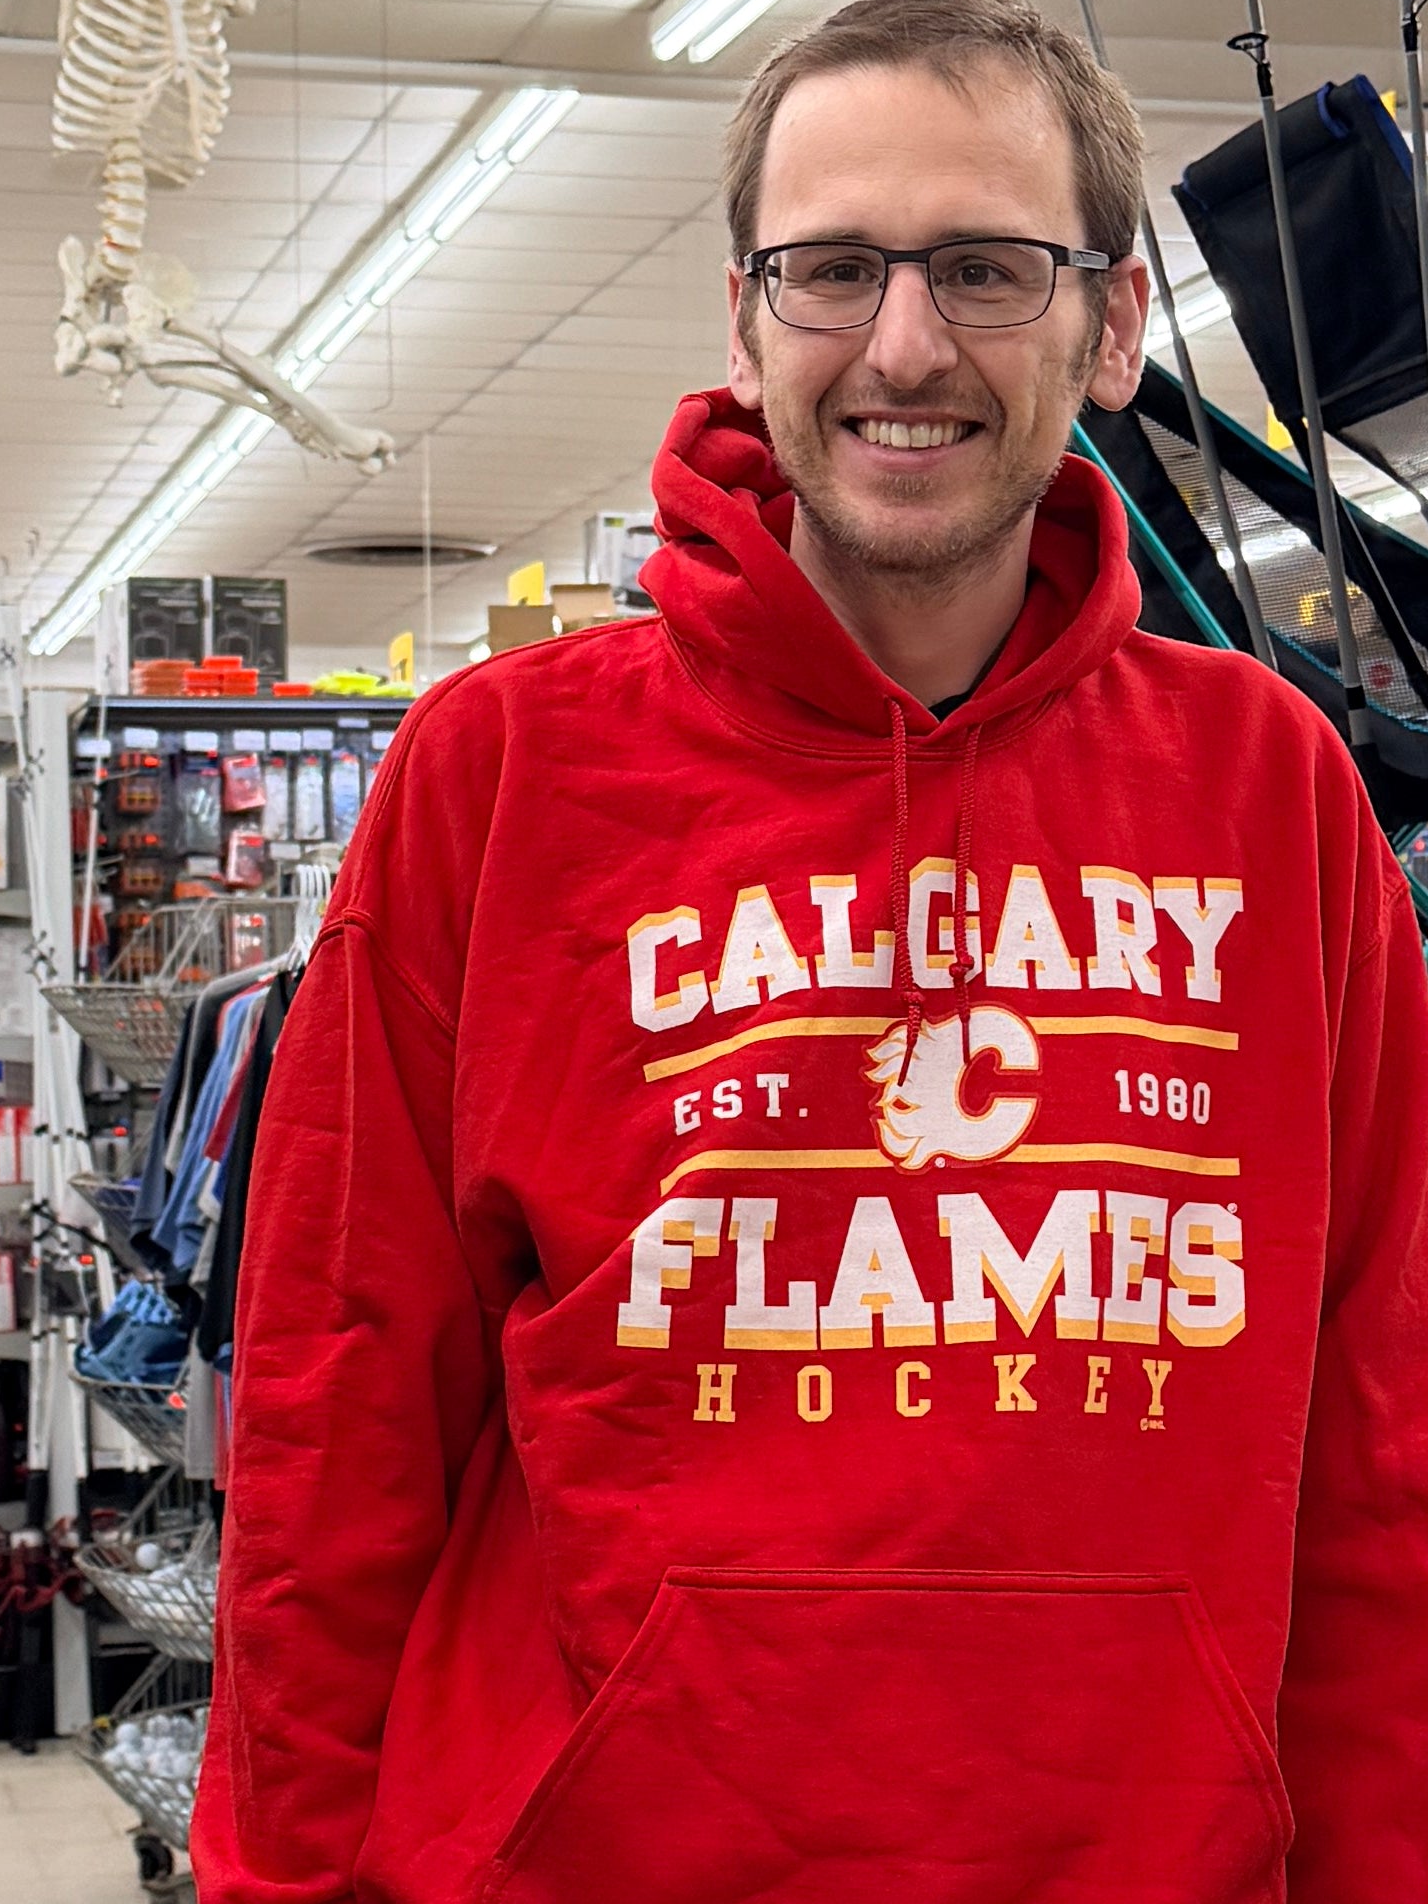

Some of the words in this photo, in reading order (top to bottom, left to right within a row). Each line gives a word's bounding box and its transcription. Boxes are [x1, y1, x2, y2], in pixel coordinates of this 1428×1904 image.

[626, 856, 1244, 1034] CALGARY
[673, 1072, 810, 1136] EST.
[1113, 1068, 1212, 1127] 1980
[616, 1188, 1247, 1351] FLAMES
[693, 1352, 1172, 1424] HOCKEY
